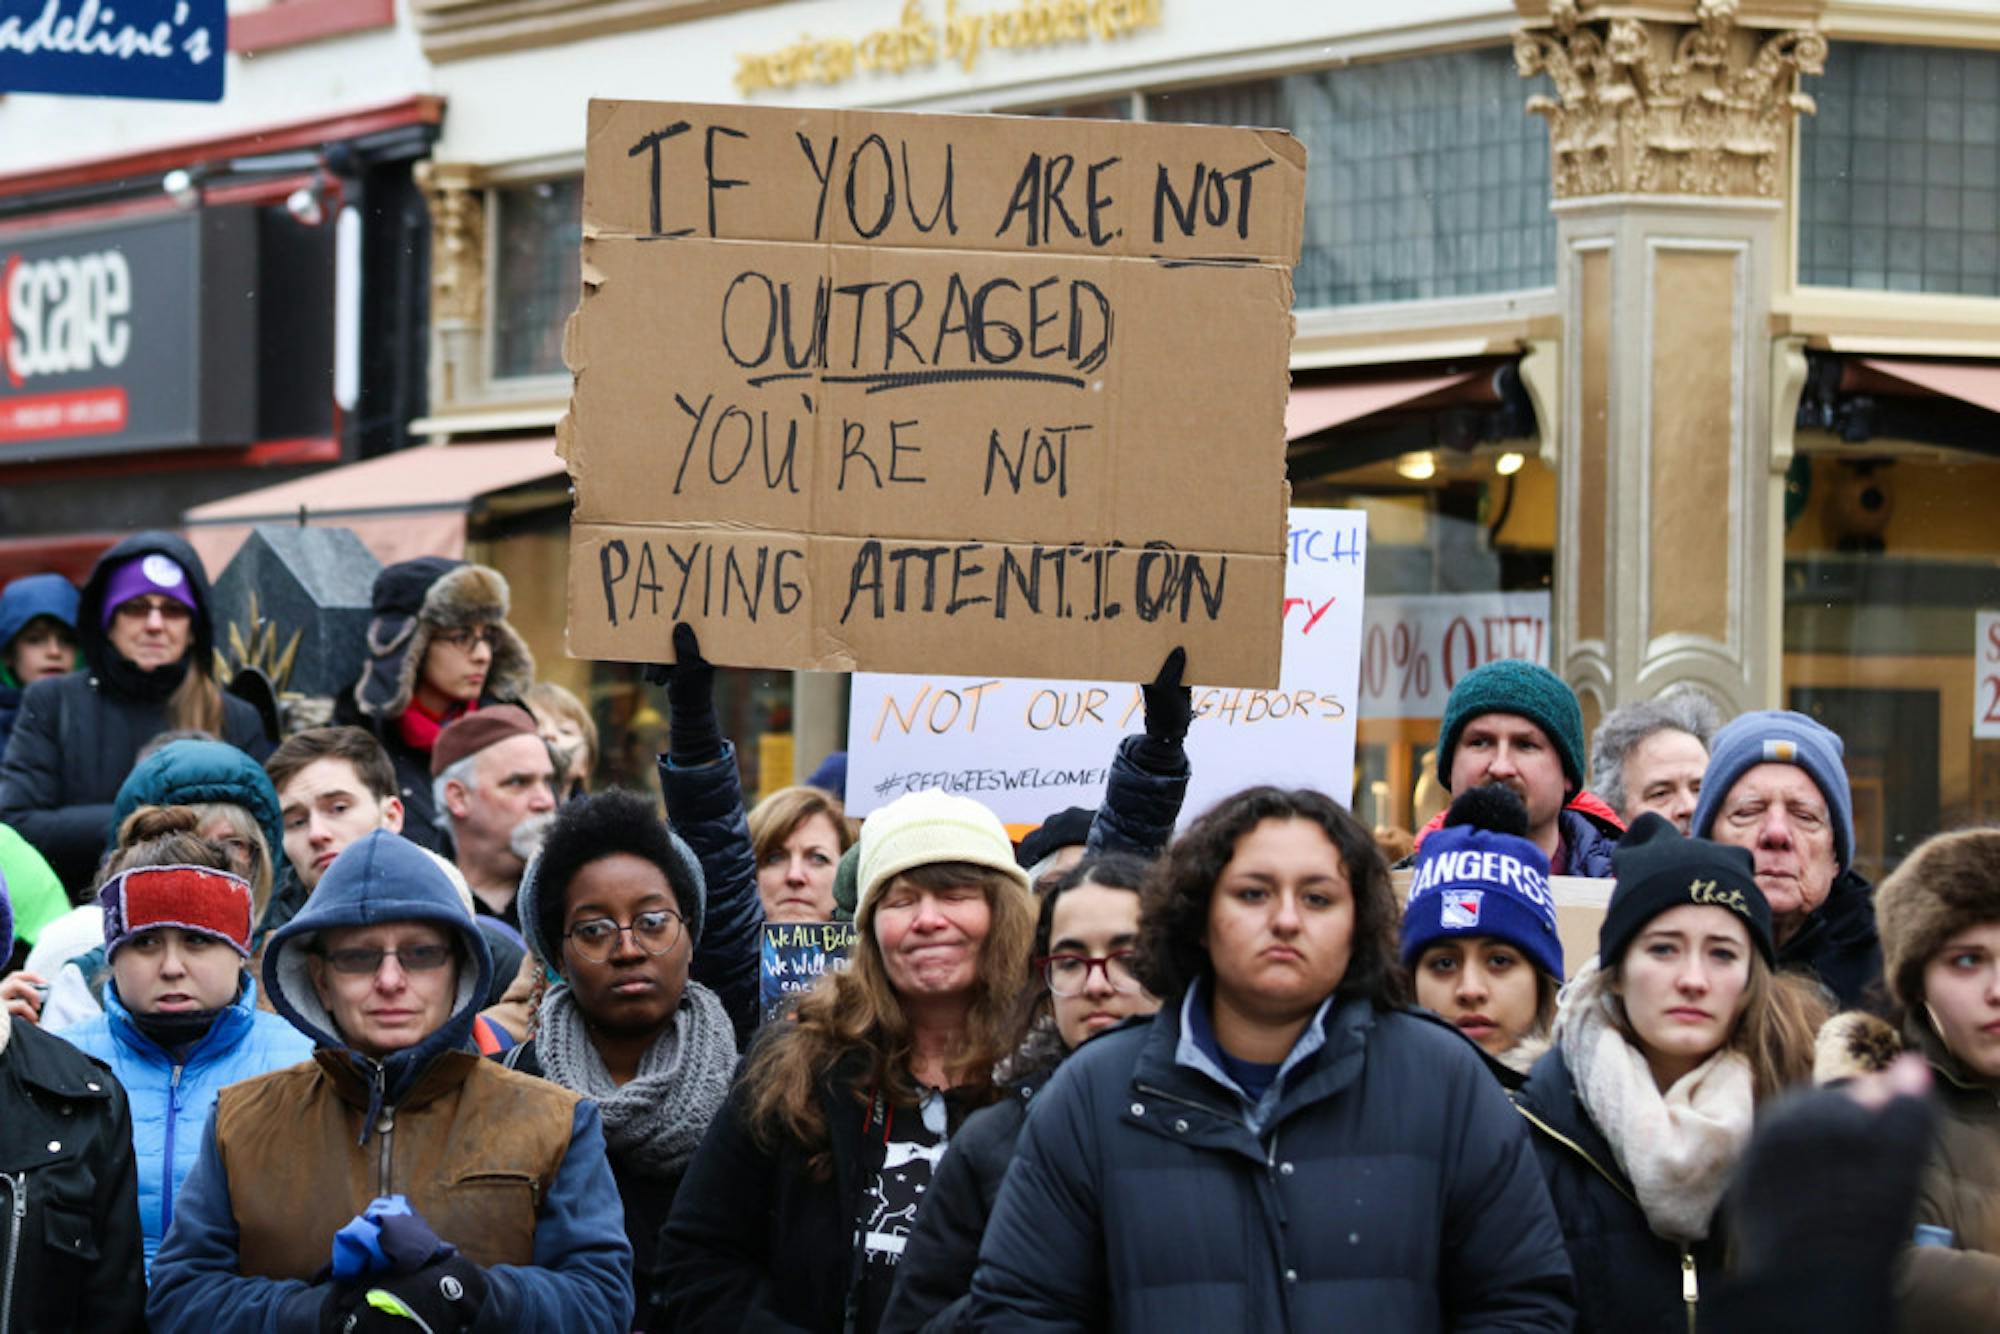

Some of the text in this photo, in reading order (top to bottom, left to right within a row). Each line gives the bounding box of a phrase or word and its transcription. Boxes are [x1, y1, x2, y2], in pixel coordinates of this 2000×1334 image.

[628, 121, 749, 241] IF
[796, 132, 958, 240] YOU
[1153, 158, 1276, 244] NOT
[721, 271, 1114, 374] OUTRAGED
[673, 393, 1094, 499] YOU'RE NOT
[600, 538, 1228, 627] PAYING ATTENTION
[1358, 621, 1431, 702] 0%
[871, 680, 1001, 743] NOT
[1024, 687, 1109, 731] OUR
[764, 953, 788, 977] We
[791, 952, 828, 977] Will
[767, 927, 789, 948] We
